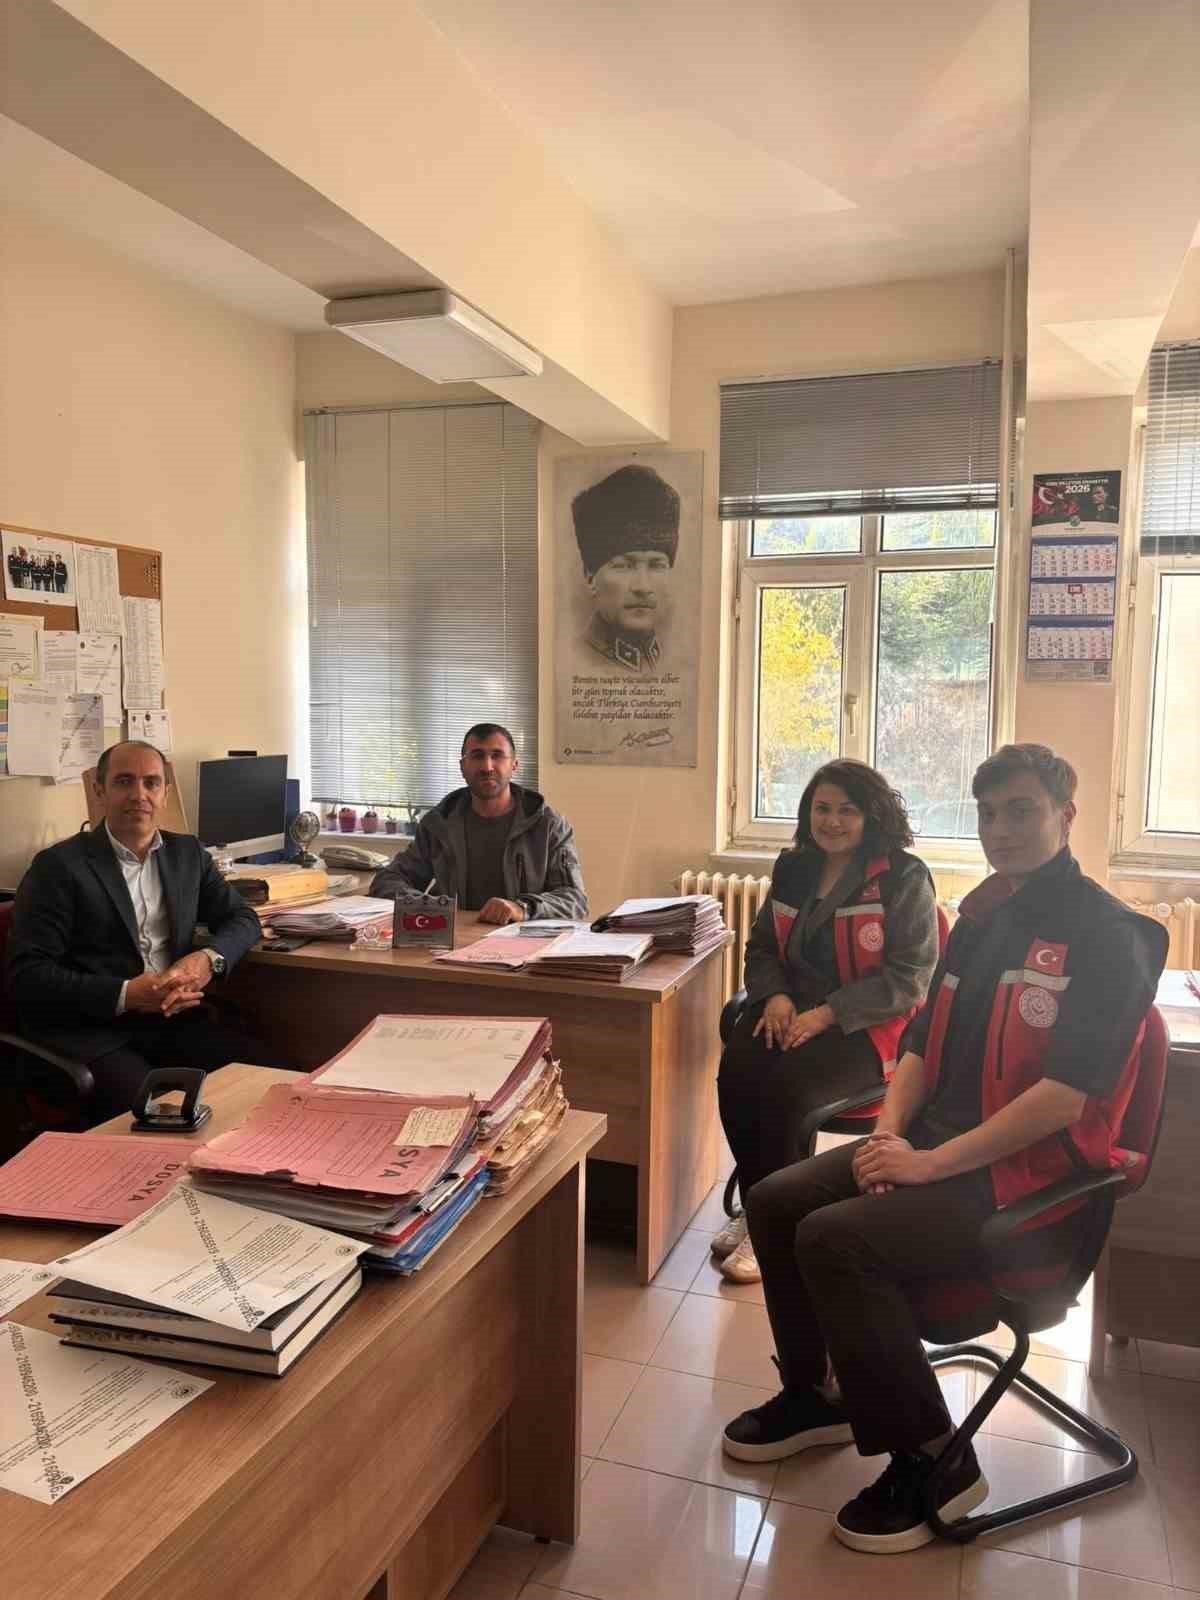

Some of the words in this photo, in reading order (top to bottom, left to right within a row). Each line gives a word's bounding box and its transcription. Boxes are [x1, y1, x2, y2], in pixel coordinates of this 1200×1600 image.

[1065, 484, 1091, 494] 2026
[377, 1149, 419, 1178] SYA
[128, 1163, 180, 1201] DOSYA
